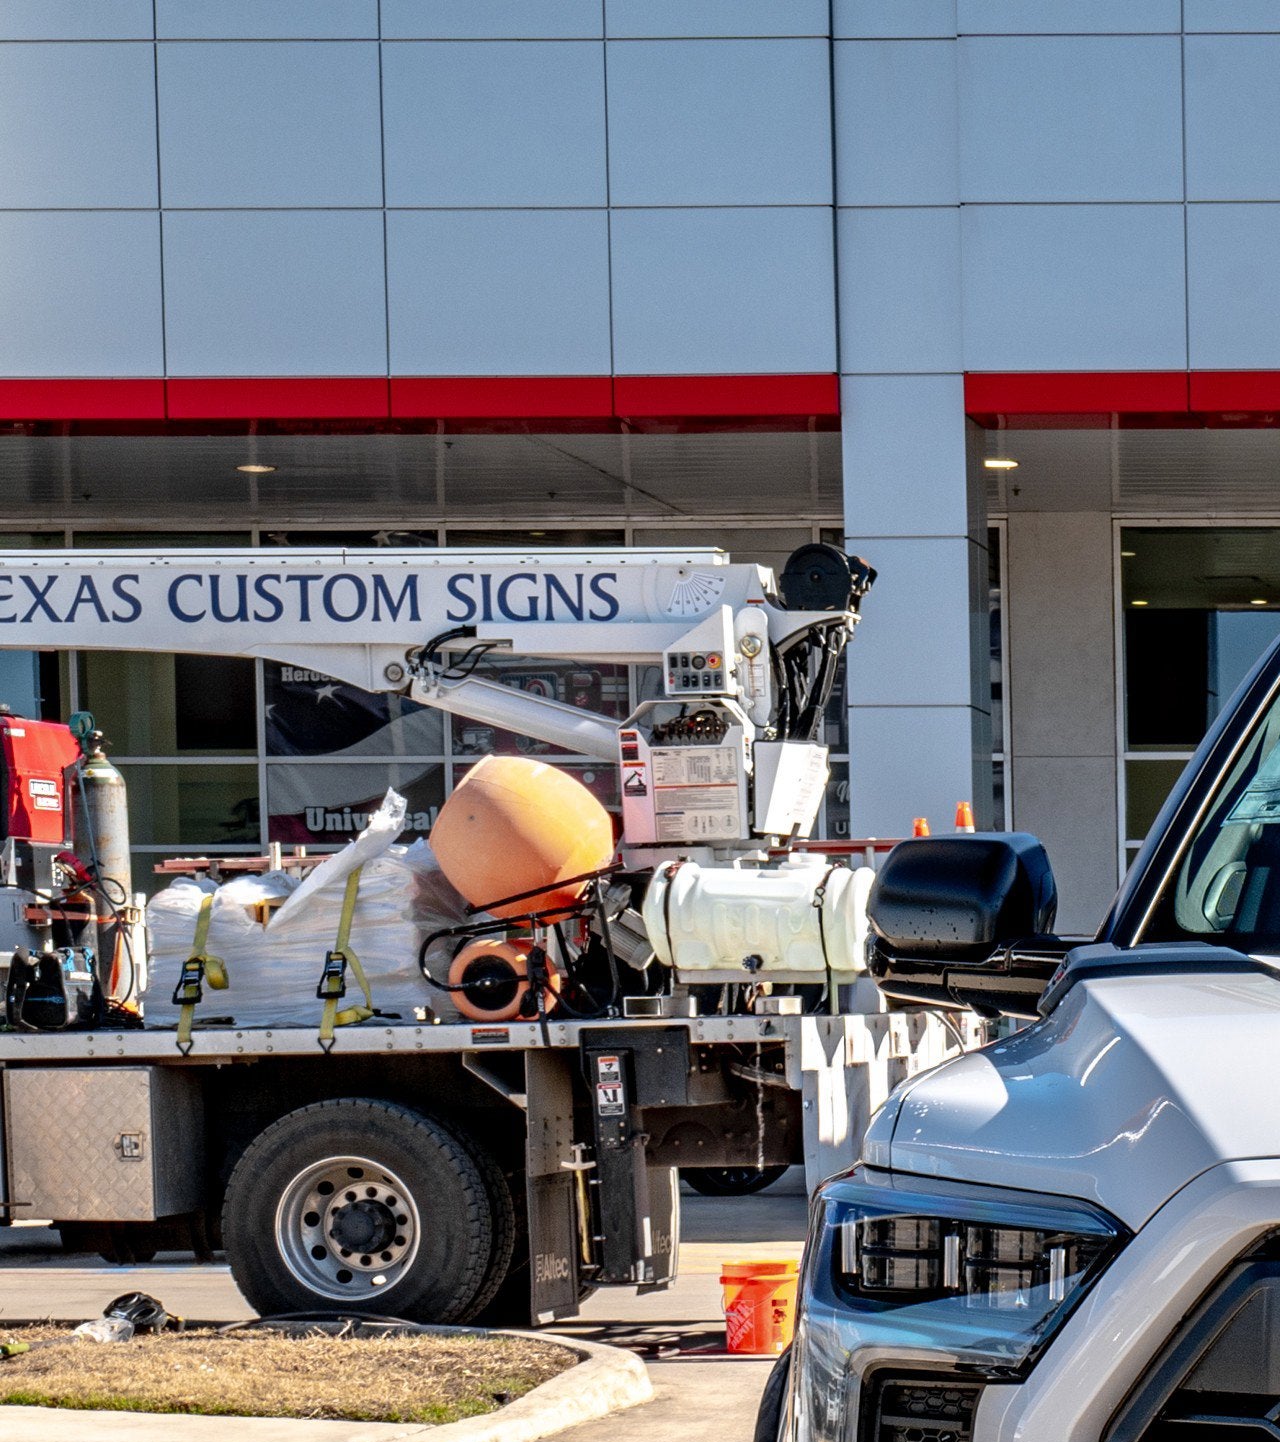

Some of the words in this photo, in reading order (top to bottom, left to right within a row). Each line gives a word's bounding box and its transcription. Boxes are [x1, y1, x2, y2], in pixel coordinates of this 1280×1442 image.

[167, 572, 422, 623] CUSTOM
[446, 571, 620, 623] SIGNS
[305, 806, 438, 832] Univsal
[542, 1253, 569, 1281] Altec
